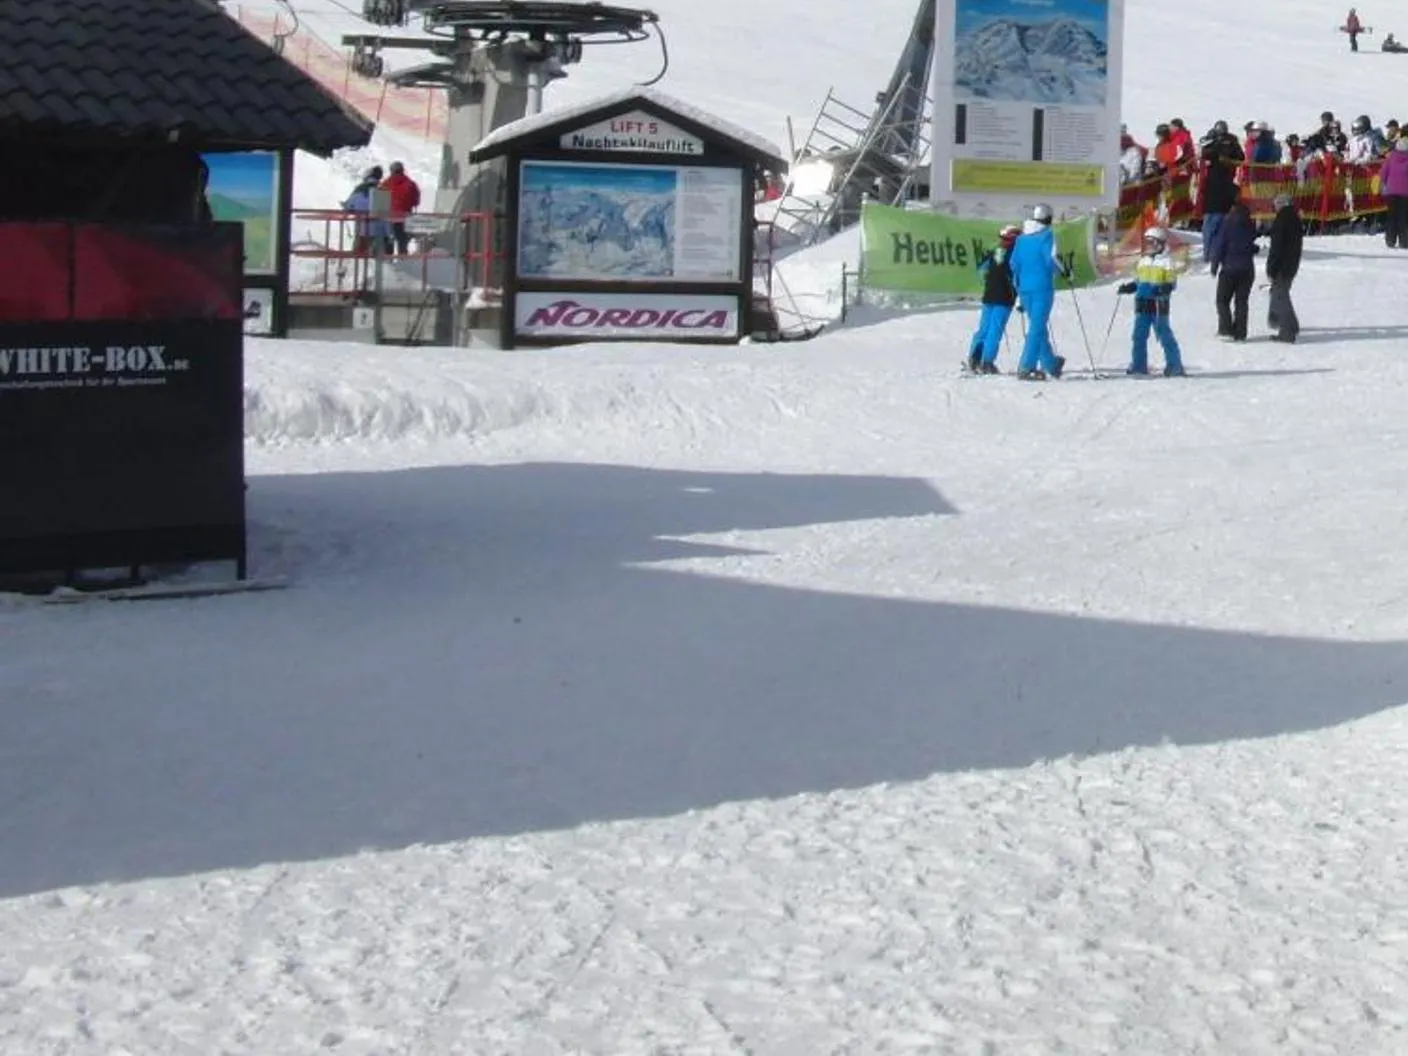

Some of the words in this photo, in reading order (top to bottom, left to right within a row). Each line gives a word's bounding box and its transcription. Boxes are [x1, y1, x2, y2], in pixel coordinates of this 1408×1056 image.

[611, 121, 643, 133] LIFT
[647, 122, 659, 134] 5
[892, 232, 968, 266] Heute
[525, 300, 728, 328] NORDICA
